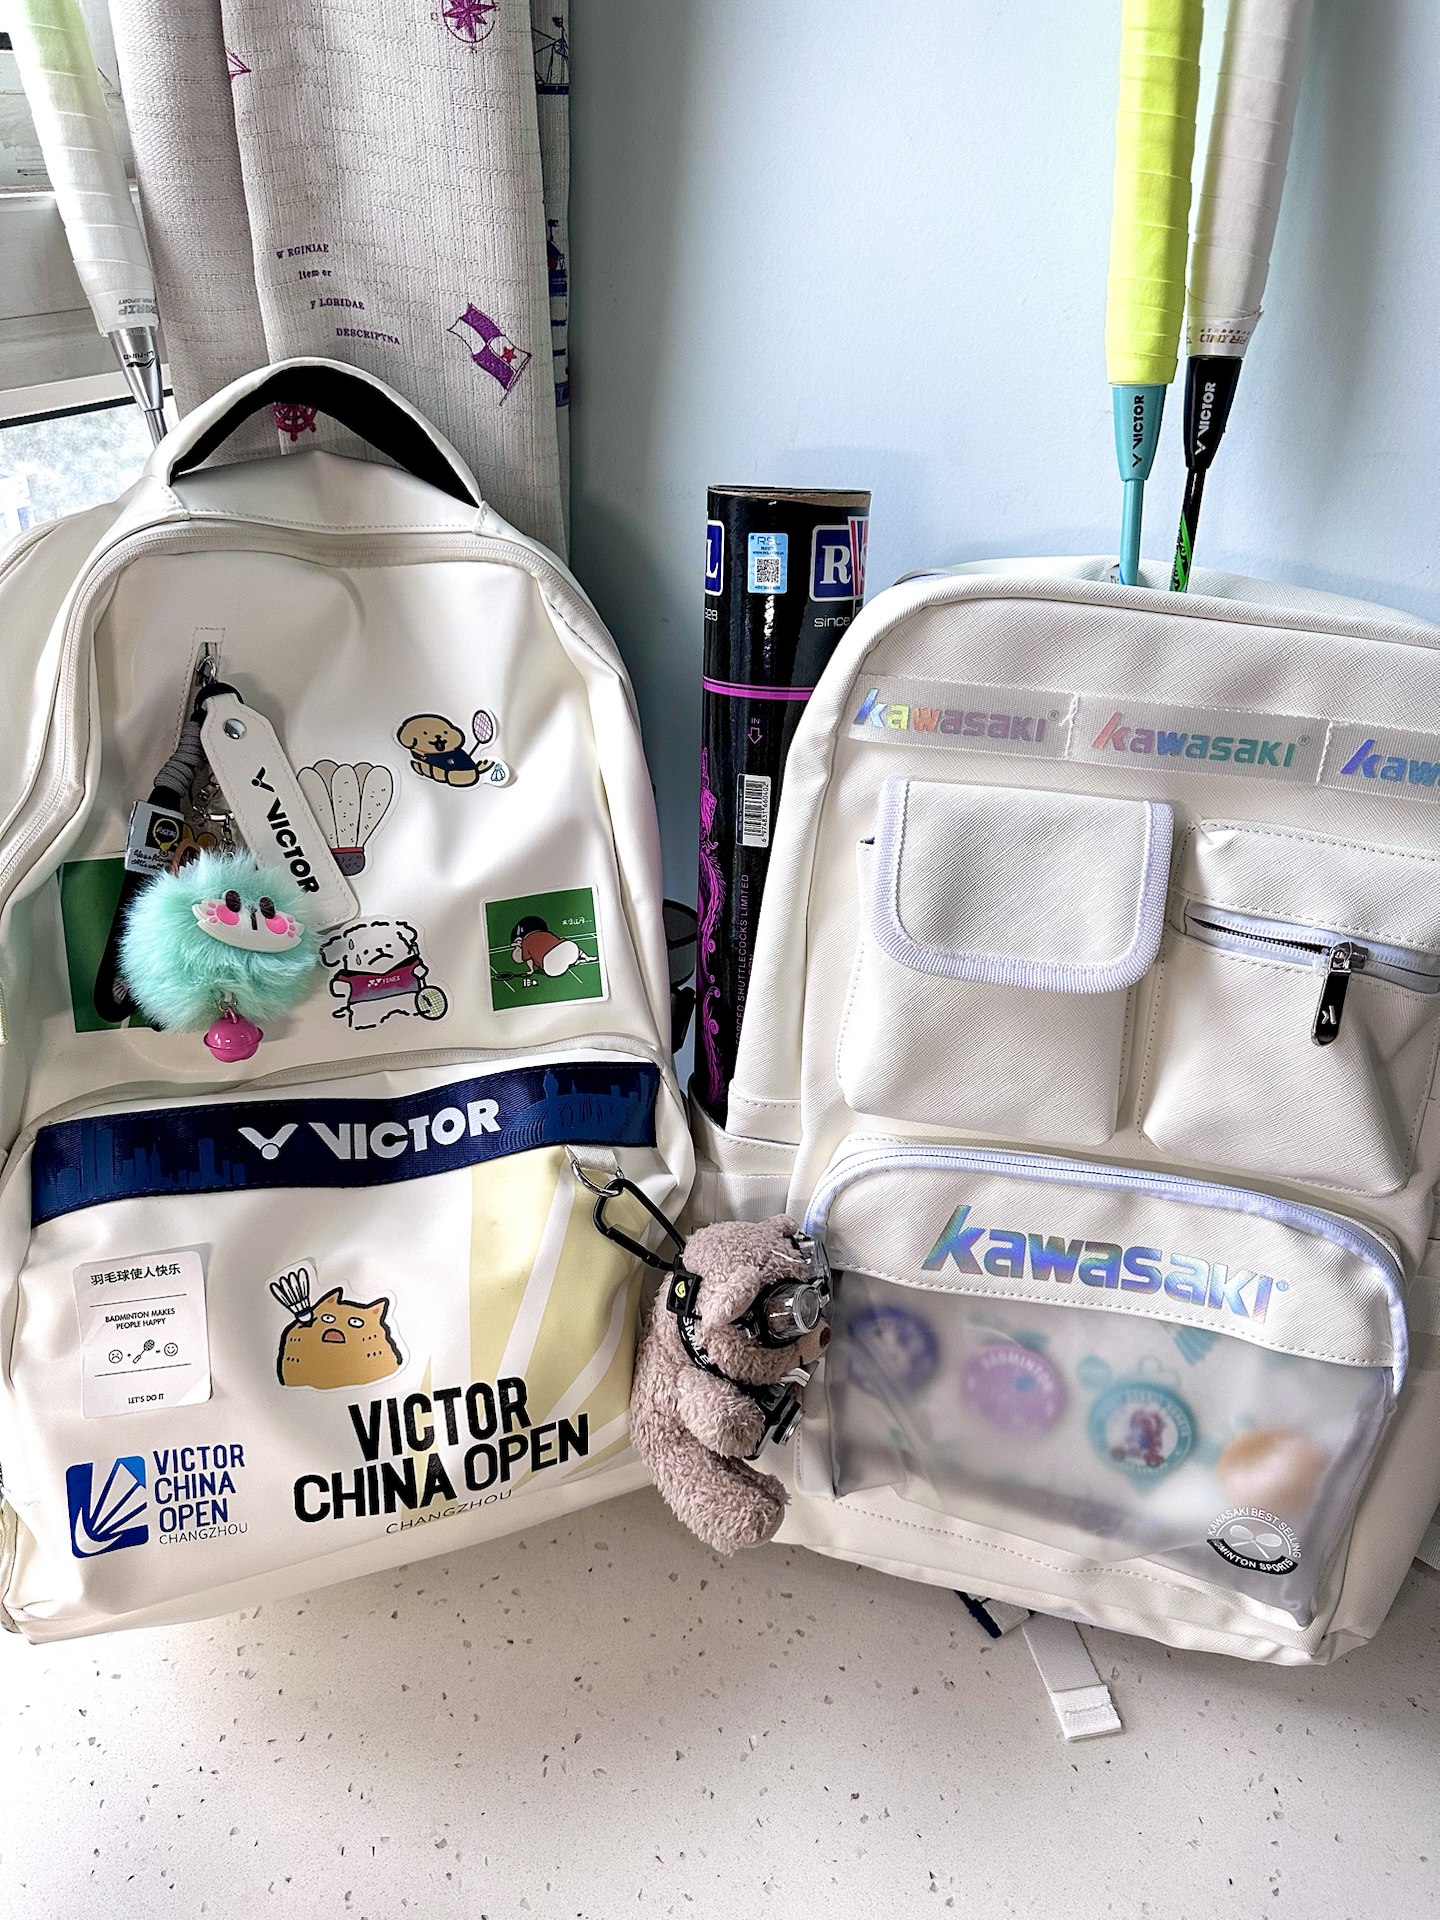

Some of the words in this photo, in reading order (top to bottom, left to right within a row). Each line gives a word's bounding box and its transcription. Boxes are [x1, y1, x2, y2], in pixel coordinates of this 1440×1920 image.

[1132, 394, 1144, 449] VICTOR
[1198, 382, 1216, 438] VICTOR
[814, 614, 850, 628] since
[852, 688, 1048, 742] kawasaki
[1090, 712, 1295, 768] kawasaki
[266, 797, 320, 894] VICTOR
[740, 874, 749, 917] LIMITED
[737, 920, 748, 1002] SHUTTLECOCKS
[308, 1098, 501, 1160] VICTOR
[90, 1263, 181, 1286] 羽毛球使人快乐
[921, 1204, 1274, 1325] kawasaki
[105, 1311, 150, 1323] BADMINTON
[151, 1308, 176, 1317] MAKES
[116, 1320, 141, 1330] PEOPLE
[142, 1318, 167, 1327] HAPPY
[128, 1396, 145, 1404] LET'S
[146, 1394, 157, 1402] DO
[348, 1376, 531, 1462] VICTOR
[153, 1444, 245, 1475] VICTOR
[294, 1453, 458, 1523] CHINA
[464, 1413, 589, 1491] OPEN
[155, 1471, 236, 1504] CHINA
[159, 1498, 228, 1533] OPEN
[159, 1522, 248, 1545] CHANGZHOU
[386, 1489, 513, 1534] CHANGZHOU
[1206, 1506, 1249, 1536] KAWASAKI
[1251, 1508, 1280, 1524] BEST
[1278, 1522, 1302, 1559] SELLING
[1259, 1558, 1294, 1572] SPORTS
